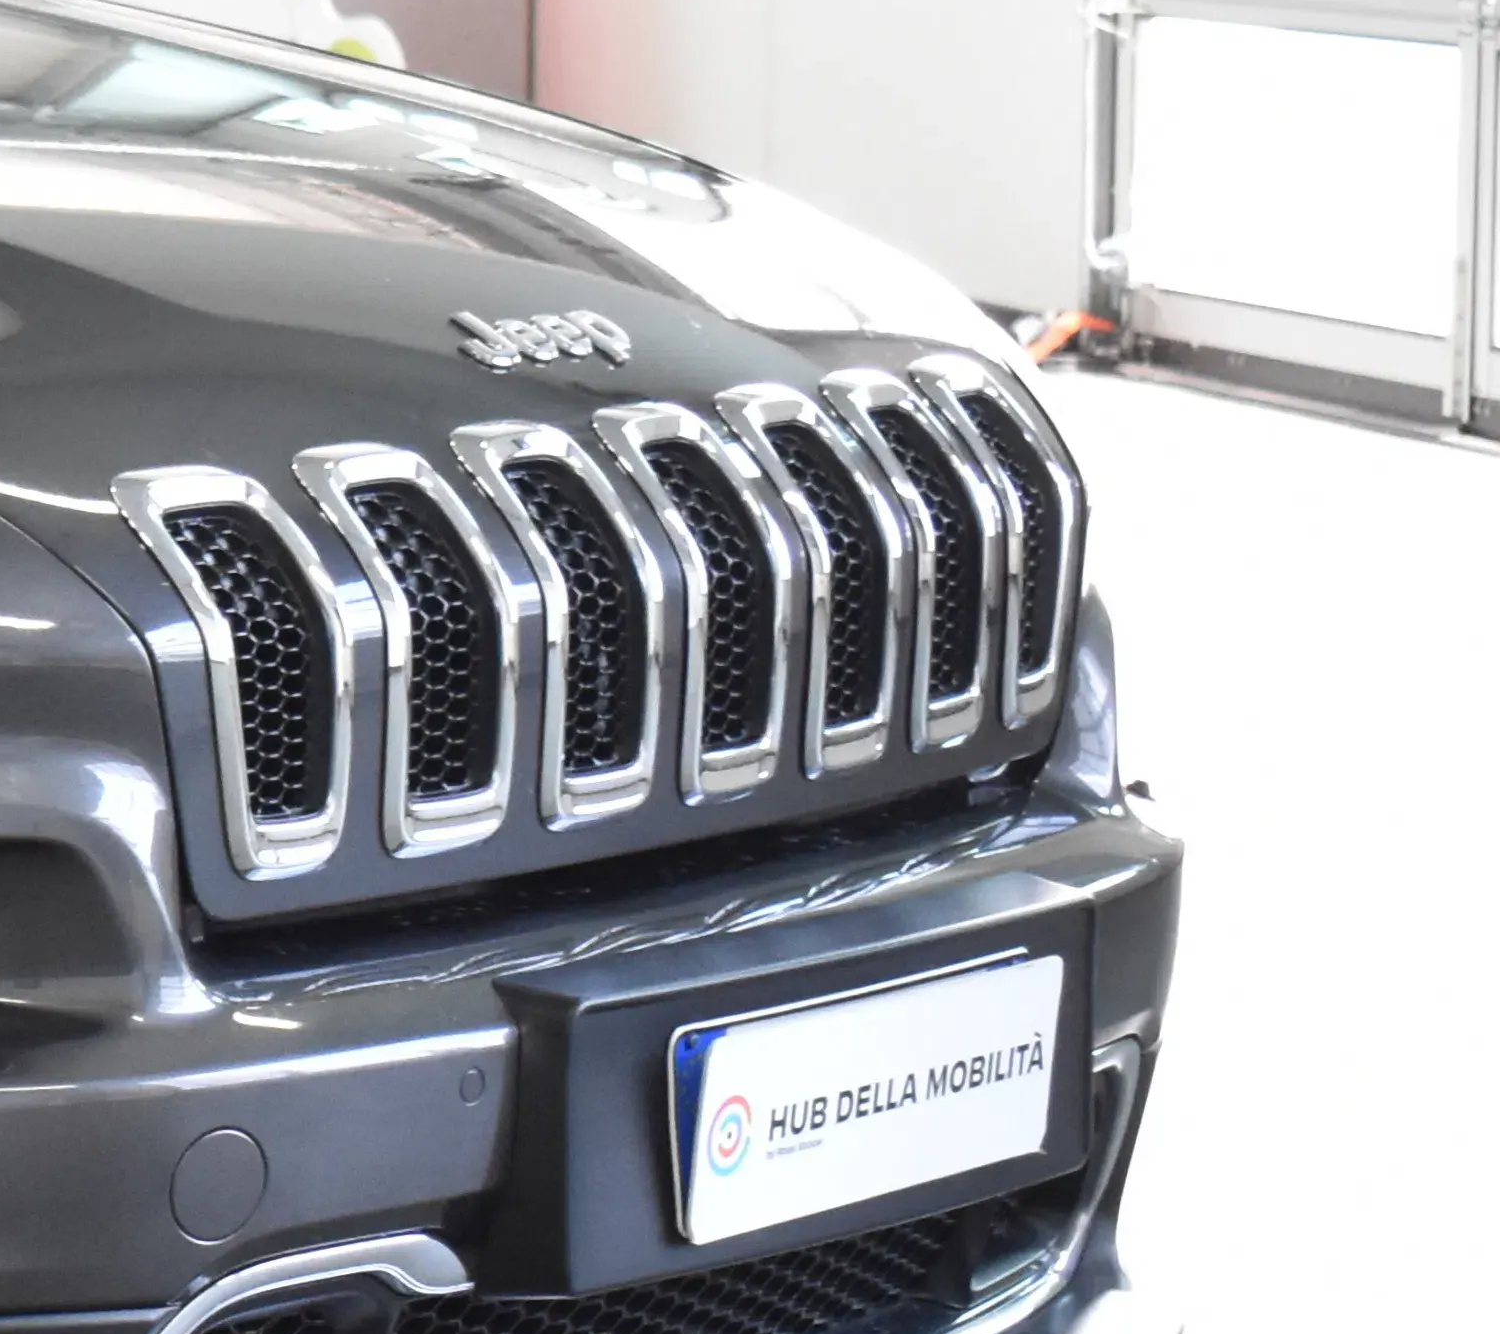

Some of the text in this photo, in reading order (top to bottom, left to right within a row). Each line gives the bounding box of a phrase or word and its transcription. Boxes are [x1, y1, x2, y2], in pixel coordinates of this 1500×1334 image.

[449, 310, 632, 367] Jeep
[766, 1031, 1044, 1142] HUB DELLA MOBILITÀ
